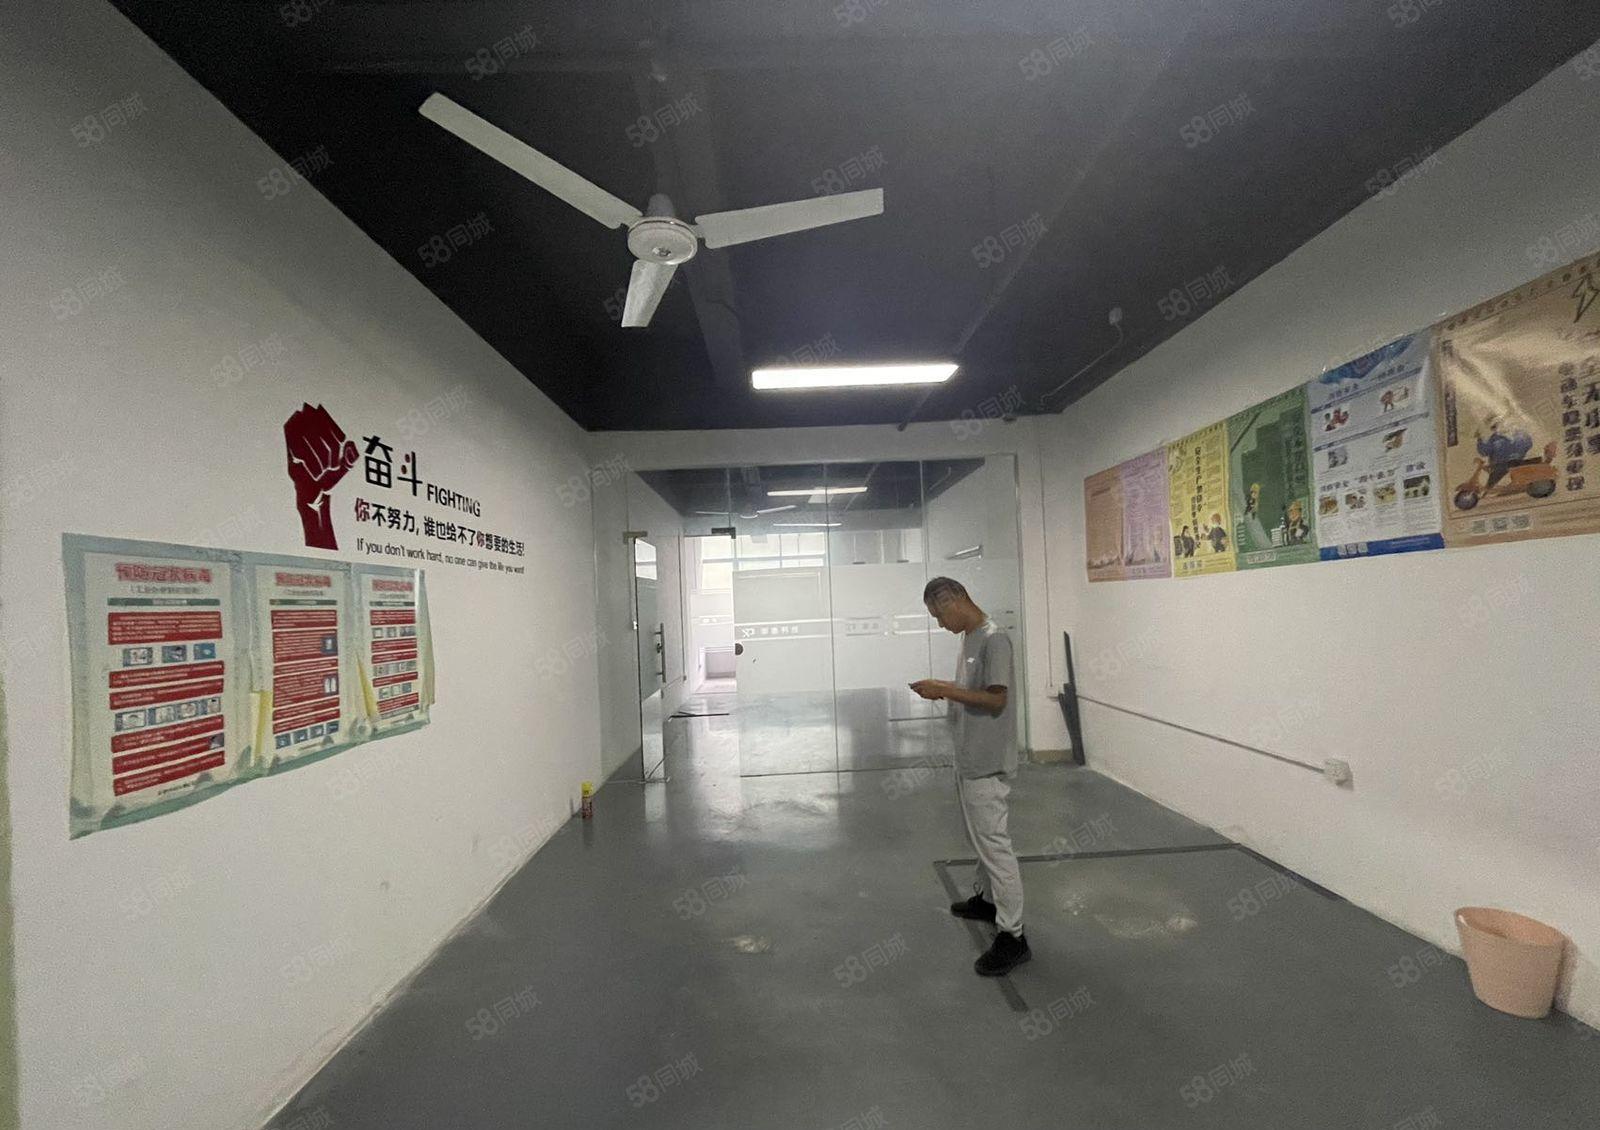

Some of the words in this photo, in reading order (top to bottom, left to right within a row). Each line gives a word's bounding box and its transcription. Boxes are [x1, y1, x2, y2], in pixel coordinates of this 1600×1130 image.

[363, 435, 422, 496] 奋斗
[427, 484, 481, 518] FIGHTING
[357, 538, 364, 551] If
[366, 543, 382, 555] you
[385, 543, 404, 556] don't
[406, 548, 425, 560] work
